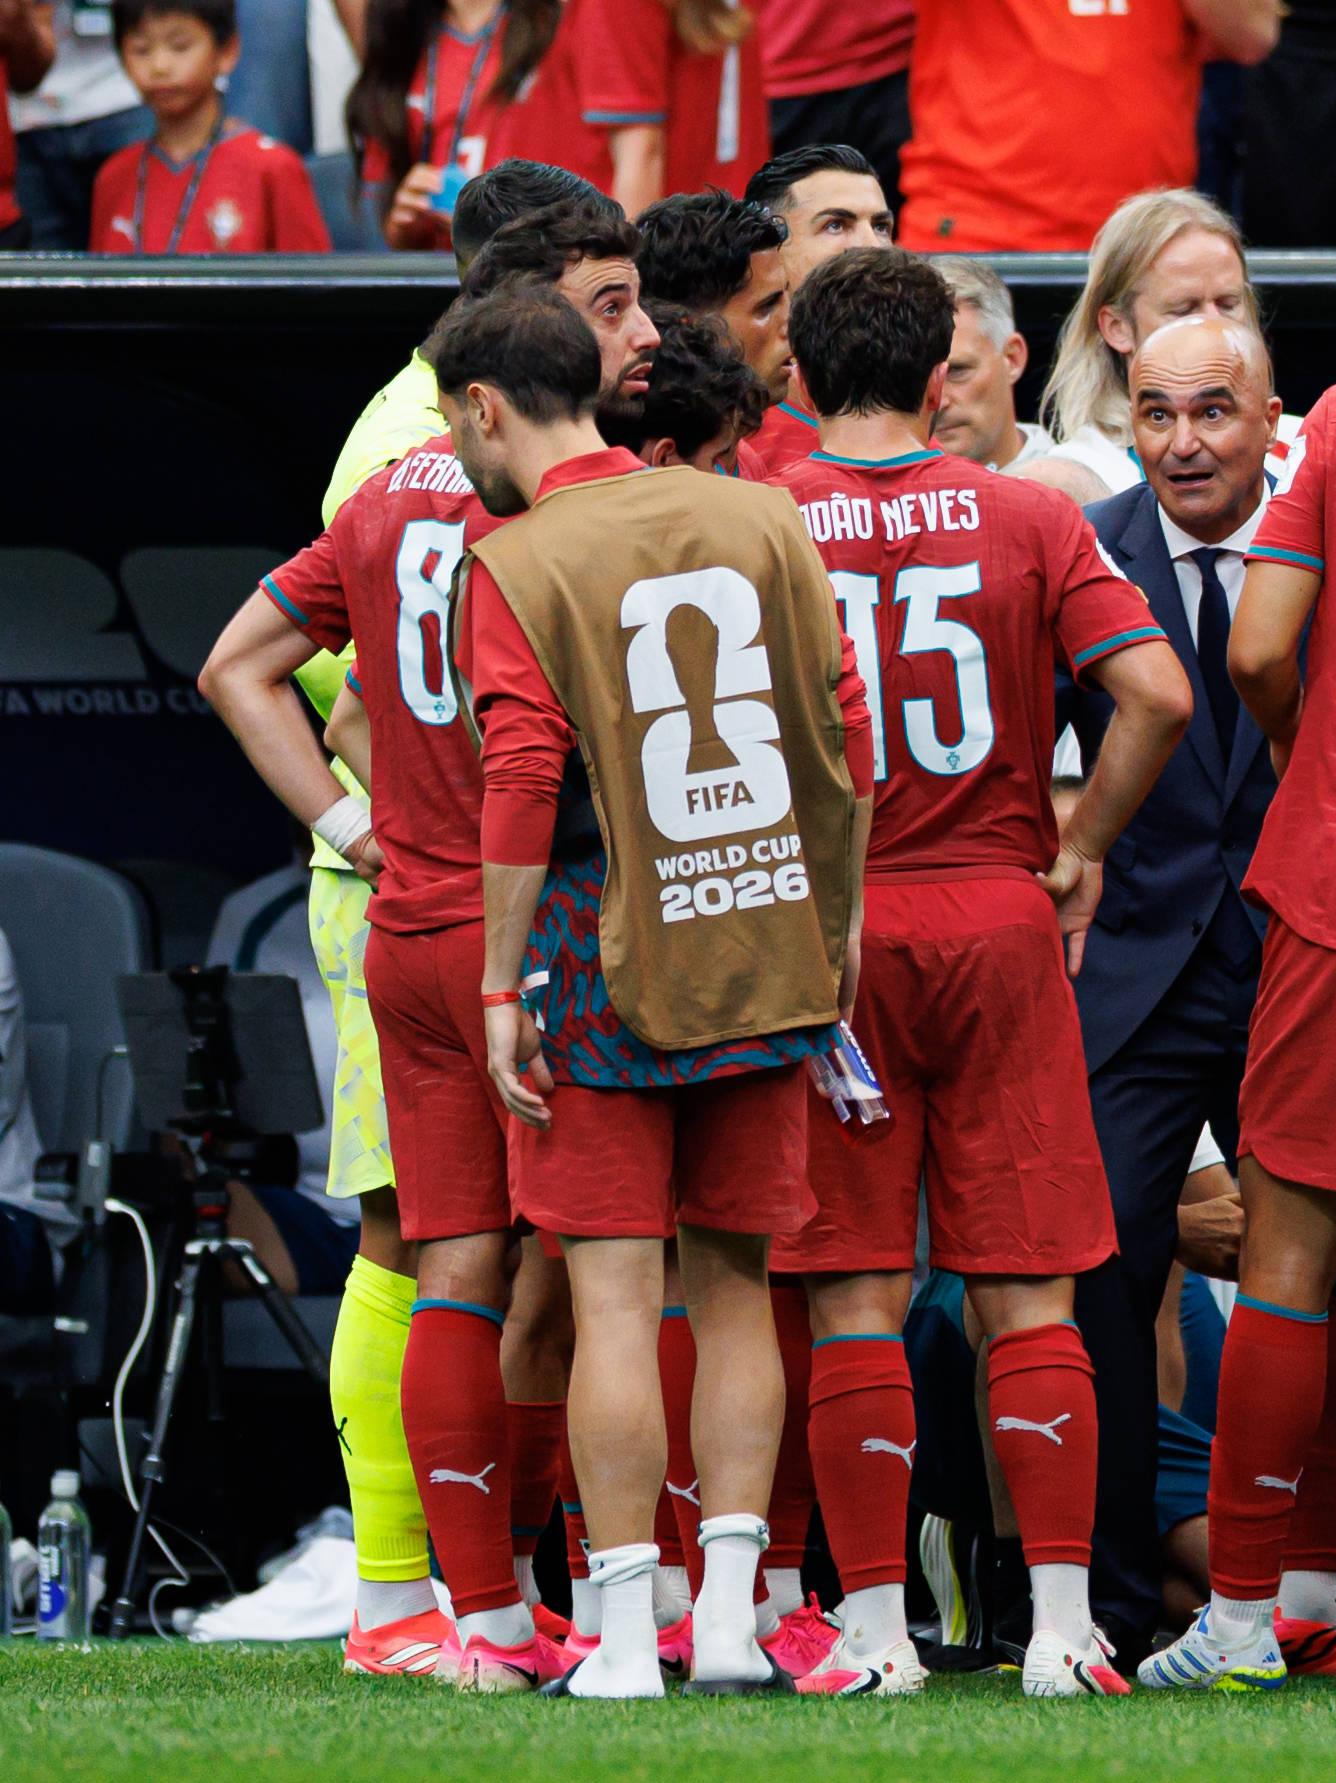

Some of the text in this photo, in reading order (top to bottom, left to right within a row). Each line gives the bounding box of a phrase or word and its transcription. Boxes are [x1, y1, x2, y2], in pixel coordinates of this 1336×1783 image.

[879, 489, 980, 541] NEVES
[395, 516, 466, 726] 8
[828, 560, 994, 783] 15
[32, 688, 160, 716] WORLD
[686, 780, 755, 815] FIFA
[655, 834, 802, 881] WORLD CUP
[659, 863, 810, 924] 2026
